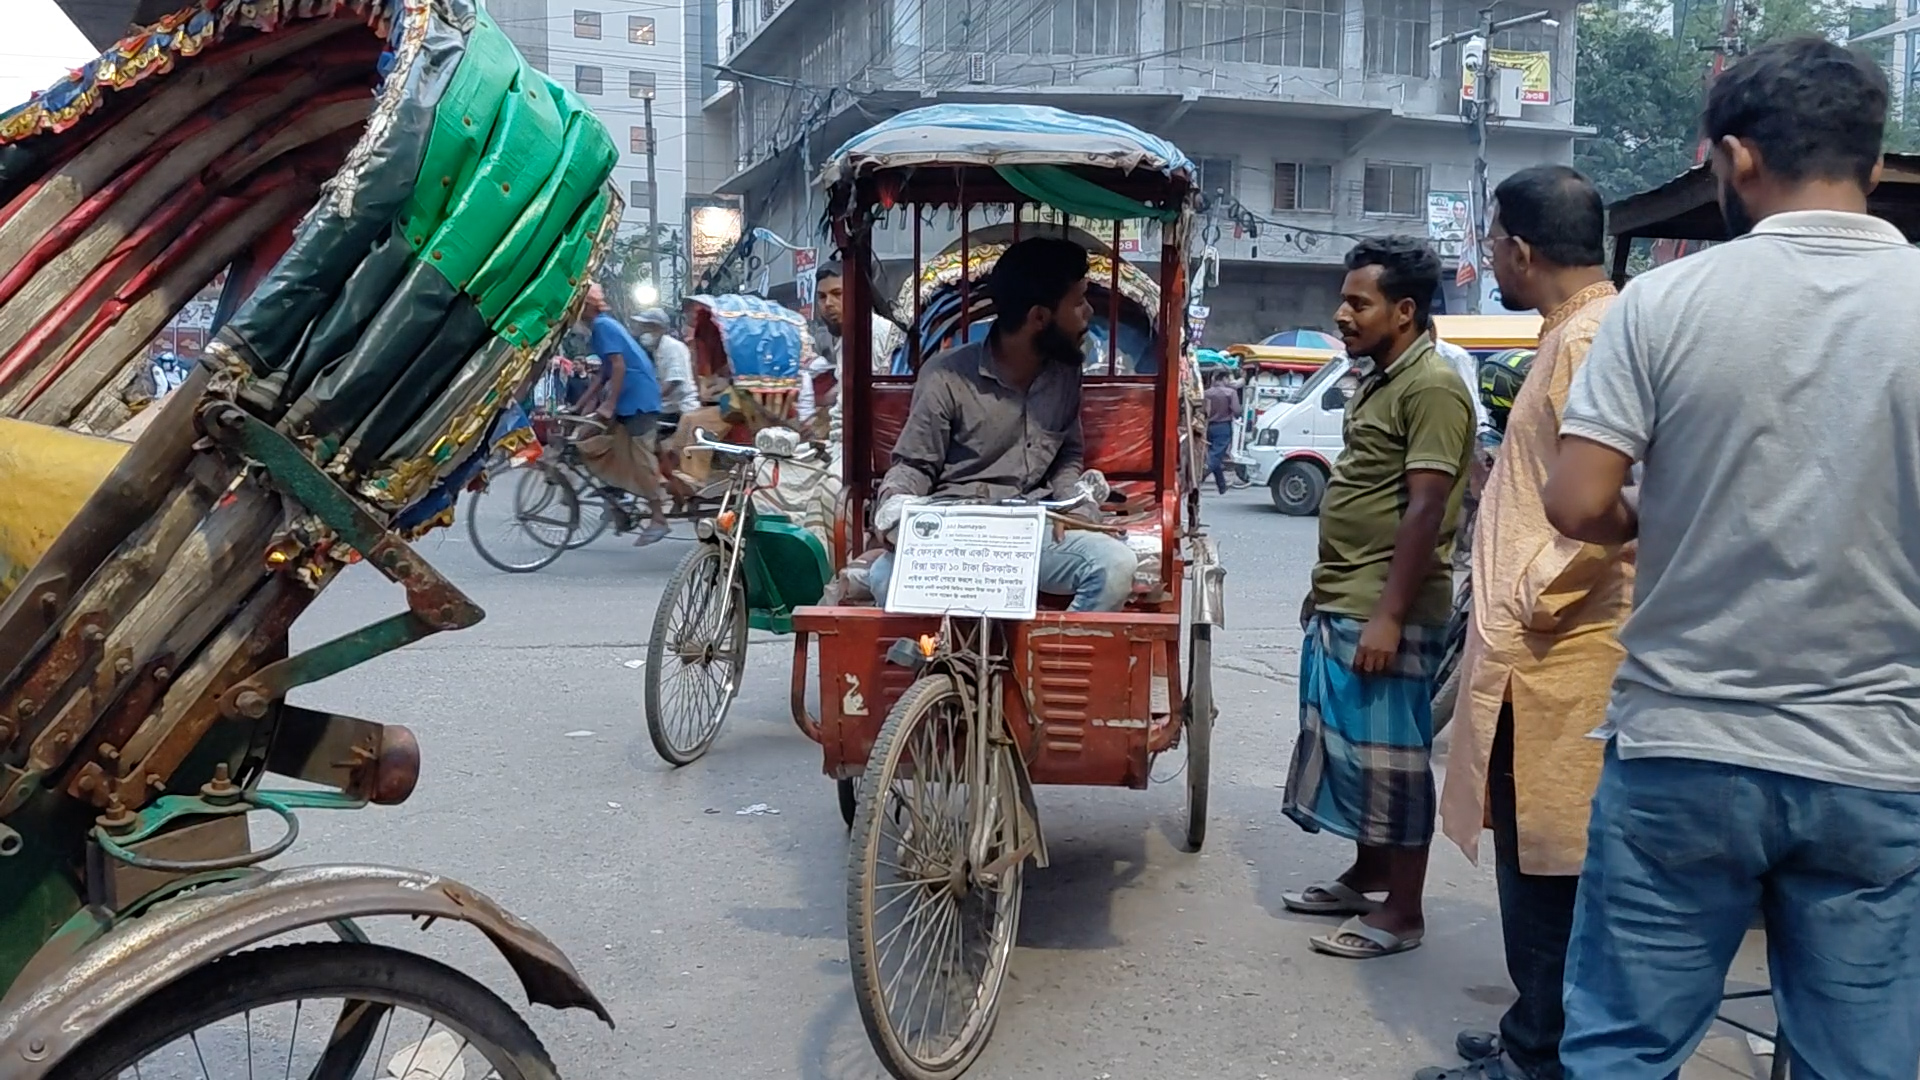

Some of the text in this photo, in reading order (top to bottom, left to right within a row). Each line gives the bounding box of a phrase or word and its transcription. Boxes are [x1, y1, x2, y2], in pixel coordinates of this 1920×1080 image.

[993, 551, 1013, 560] ফলো
[949, 563, 960, 571] ১০
[962, 561, 980, 572] টাকা
